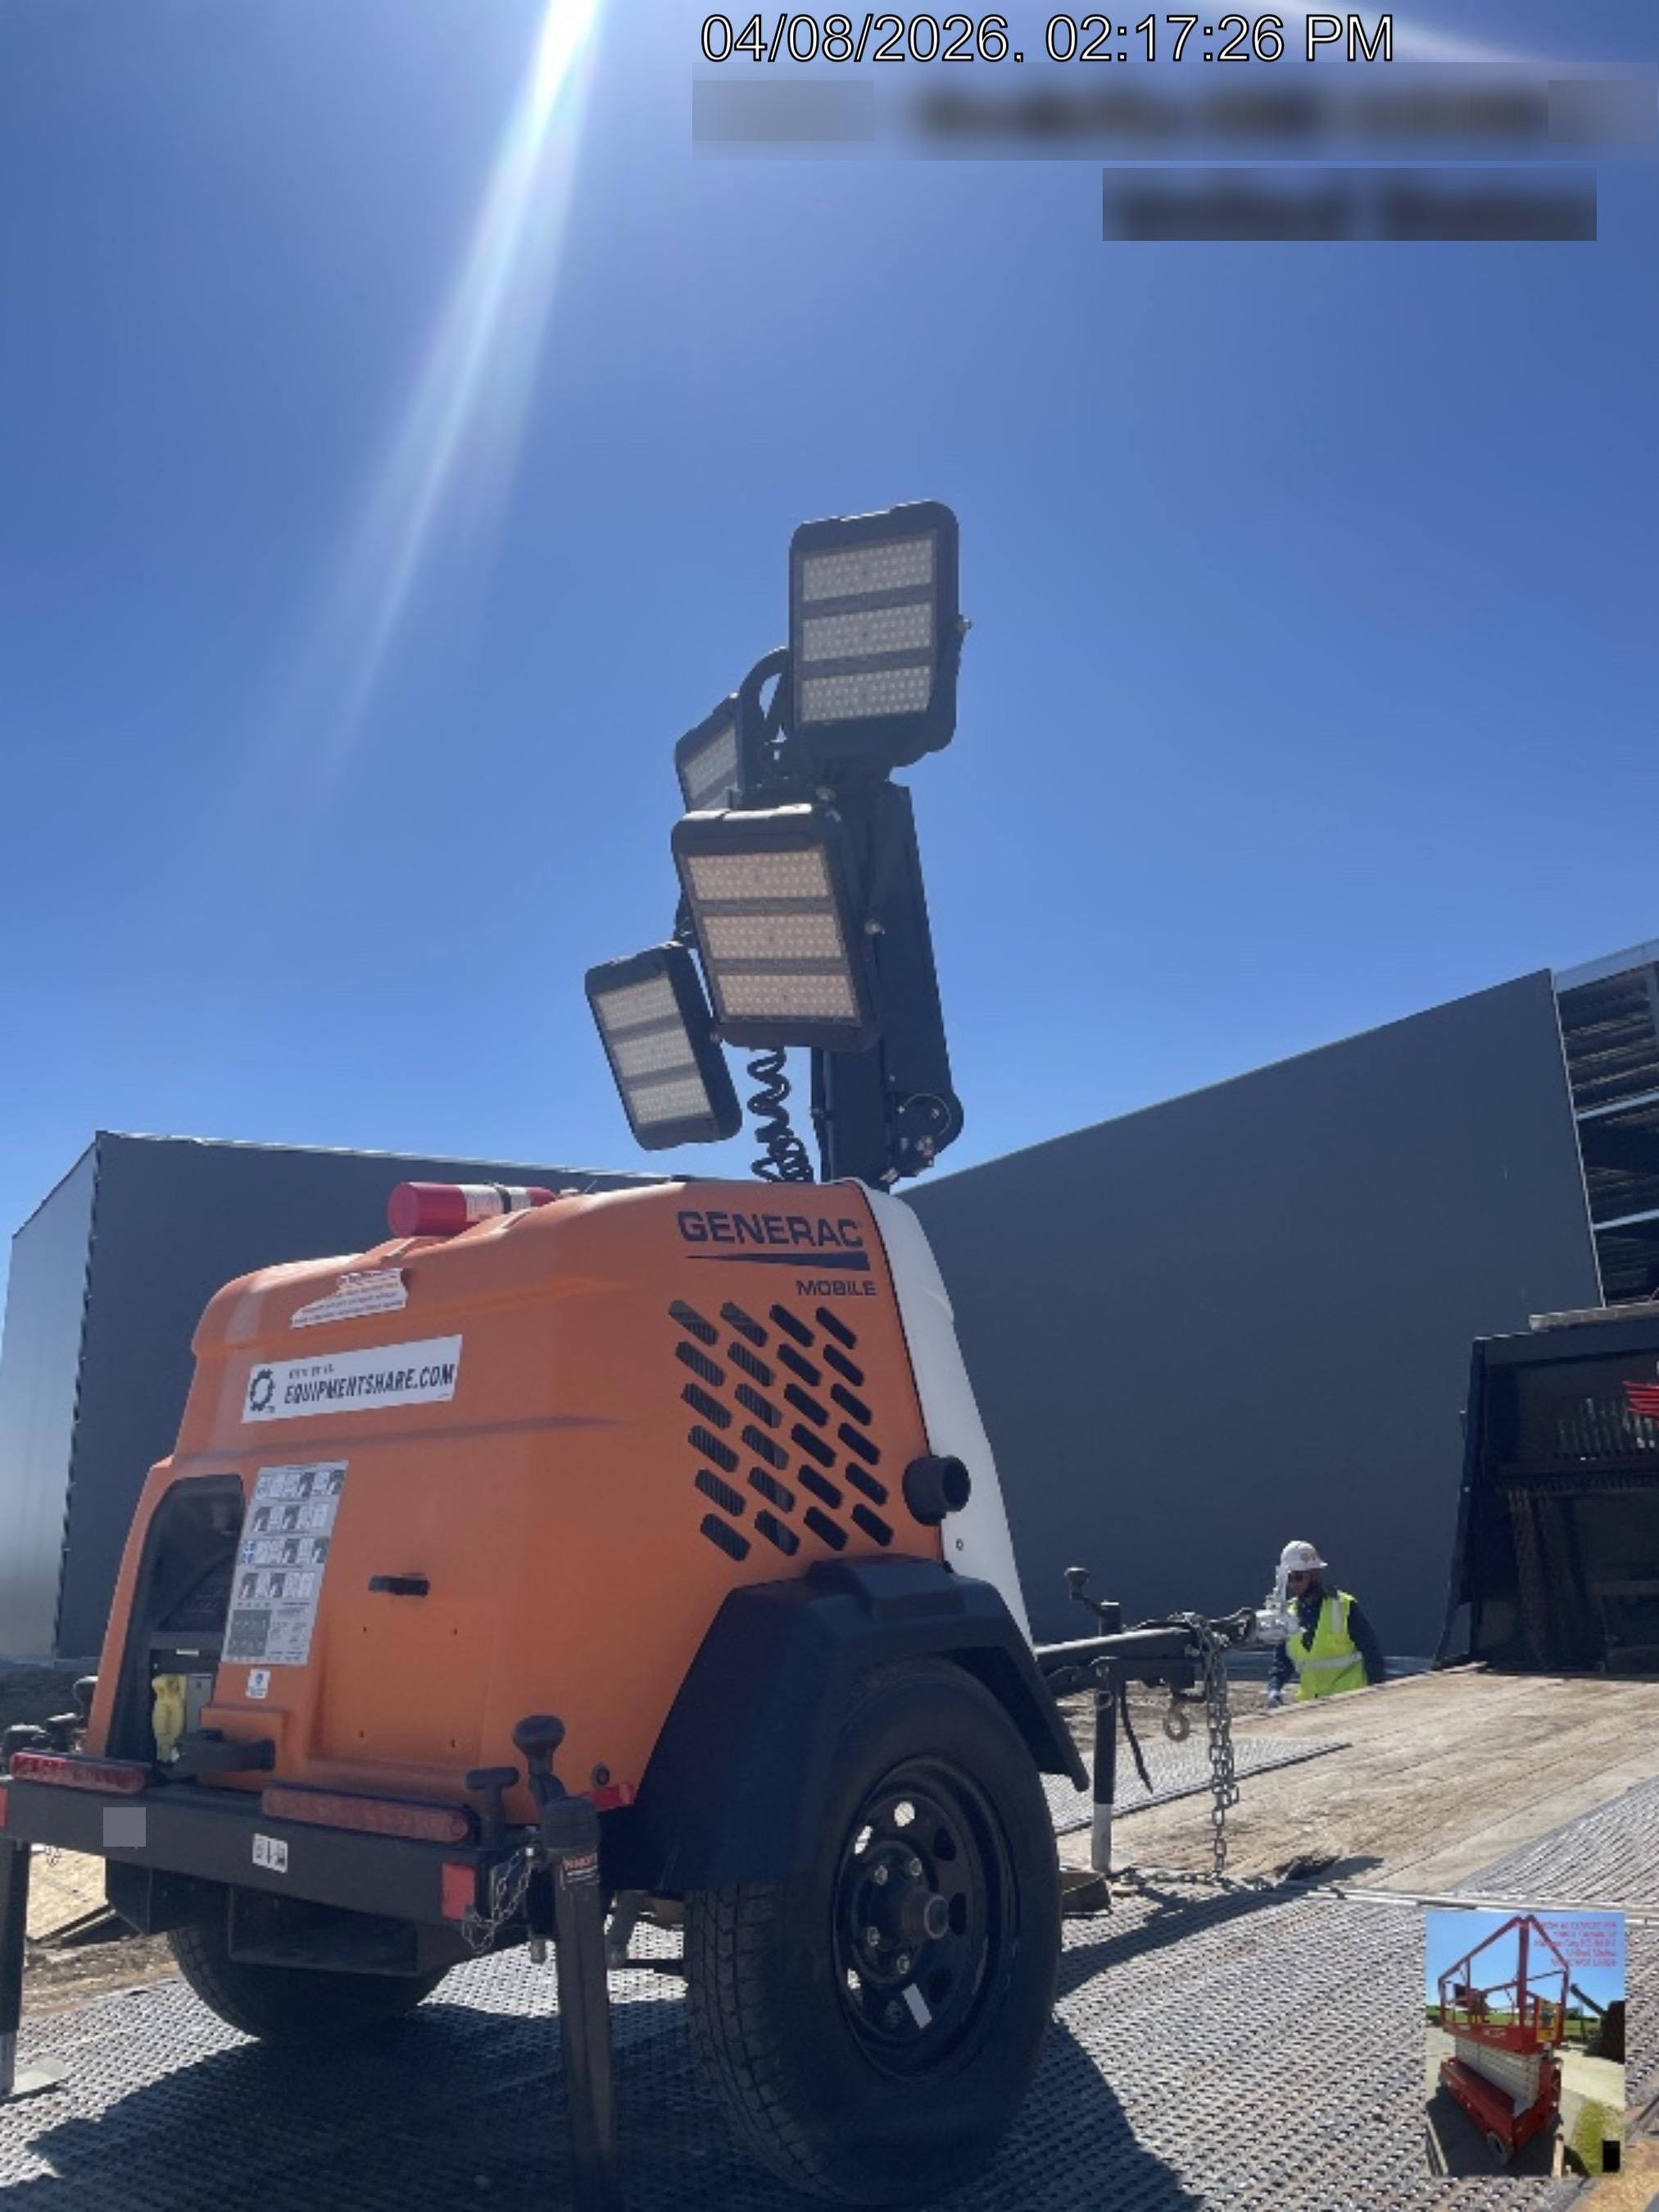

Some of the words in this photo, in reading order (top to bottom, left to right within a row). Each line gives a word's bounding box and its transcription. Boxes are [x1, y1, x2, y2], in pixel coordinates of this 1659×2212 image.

[677, 1210, 864, 1247] GENERAC
[796, 1279, 877, 1296] MOBILE
[284, 1362, 456, 1404] EQUIPMENTSHARE.COM
